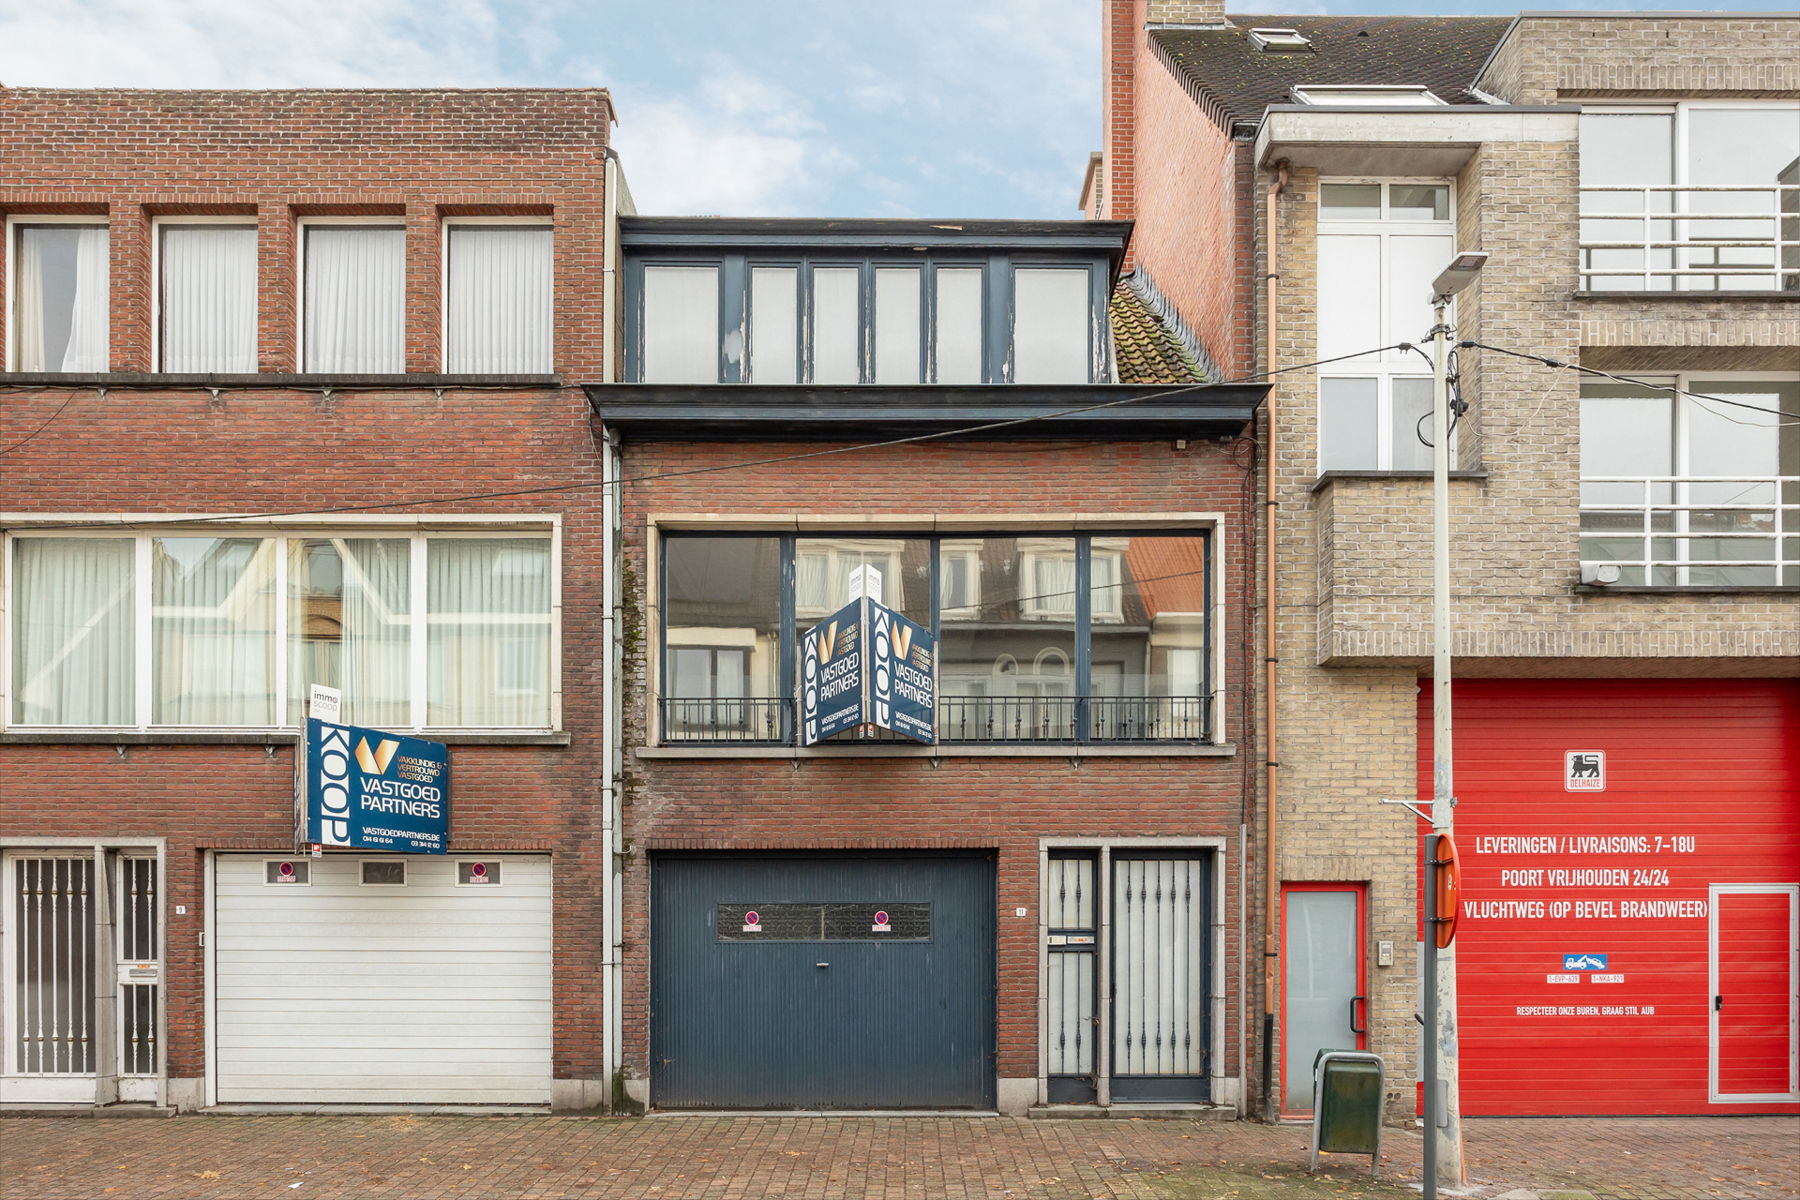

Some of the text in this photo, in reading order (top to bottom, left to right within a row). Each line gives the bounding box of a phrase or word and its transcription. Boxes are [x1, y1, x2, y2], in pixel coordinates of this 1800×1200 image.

[820, 651, 859, 684] VASTGOED
[874, 606, 890, 725] KOOP
[804, 625, 818, 741] KOOP
[894, 660, 933, 693] VASTGOED
[820, 670, 859, 702] PARTNERS
[894, 678, 933, 709] PARTNERS
[313, 690, 339, 704] immo
[313, 700, 338, 712] scoop
[396, 755, 443, 770] VAKKUNDIG &
[396, 763, 441, 777] VERTROUWD
[321, 725, 350, 844] KOOP
[396, 771, 434, 783] VASTGOED
[1569, 778, 1601, 788] DELHAIZE
[359, 776, 441, 802] VASTGOED
[360, 794, 441, 819] PARTNERS
[362, 826, 441, 842] VASTGOEDPARTNERS.BE
[1476, 836, 1695, 854] LEVERINGEN / LIVRAISONS: 7-18U
[1501, 869, 1670, 887] POORT VRIJHOUDEN 24/24
[1463, 901, 1708, 919] VLUCHTWEG (OP BEVEL BRANDWEER)
[1516, 1006, 1655, 1016] RESPECTEER ONZE BUREN, GRAAG STIL AUB
